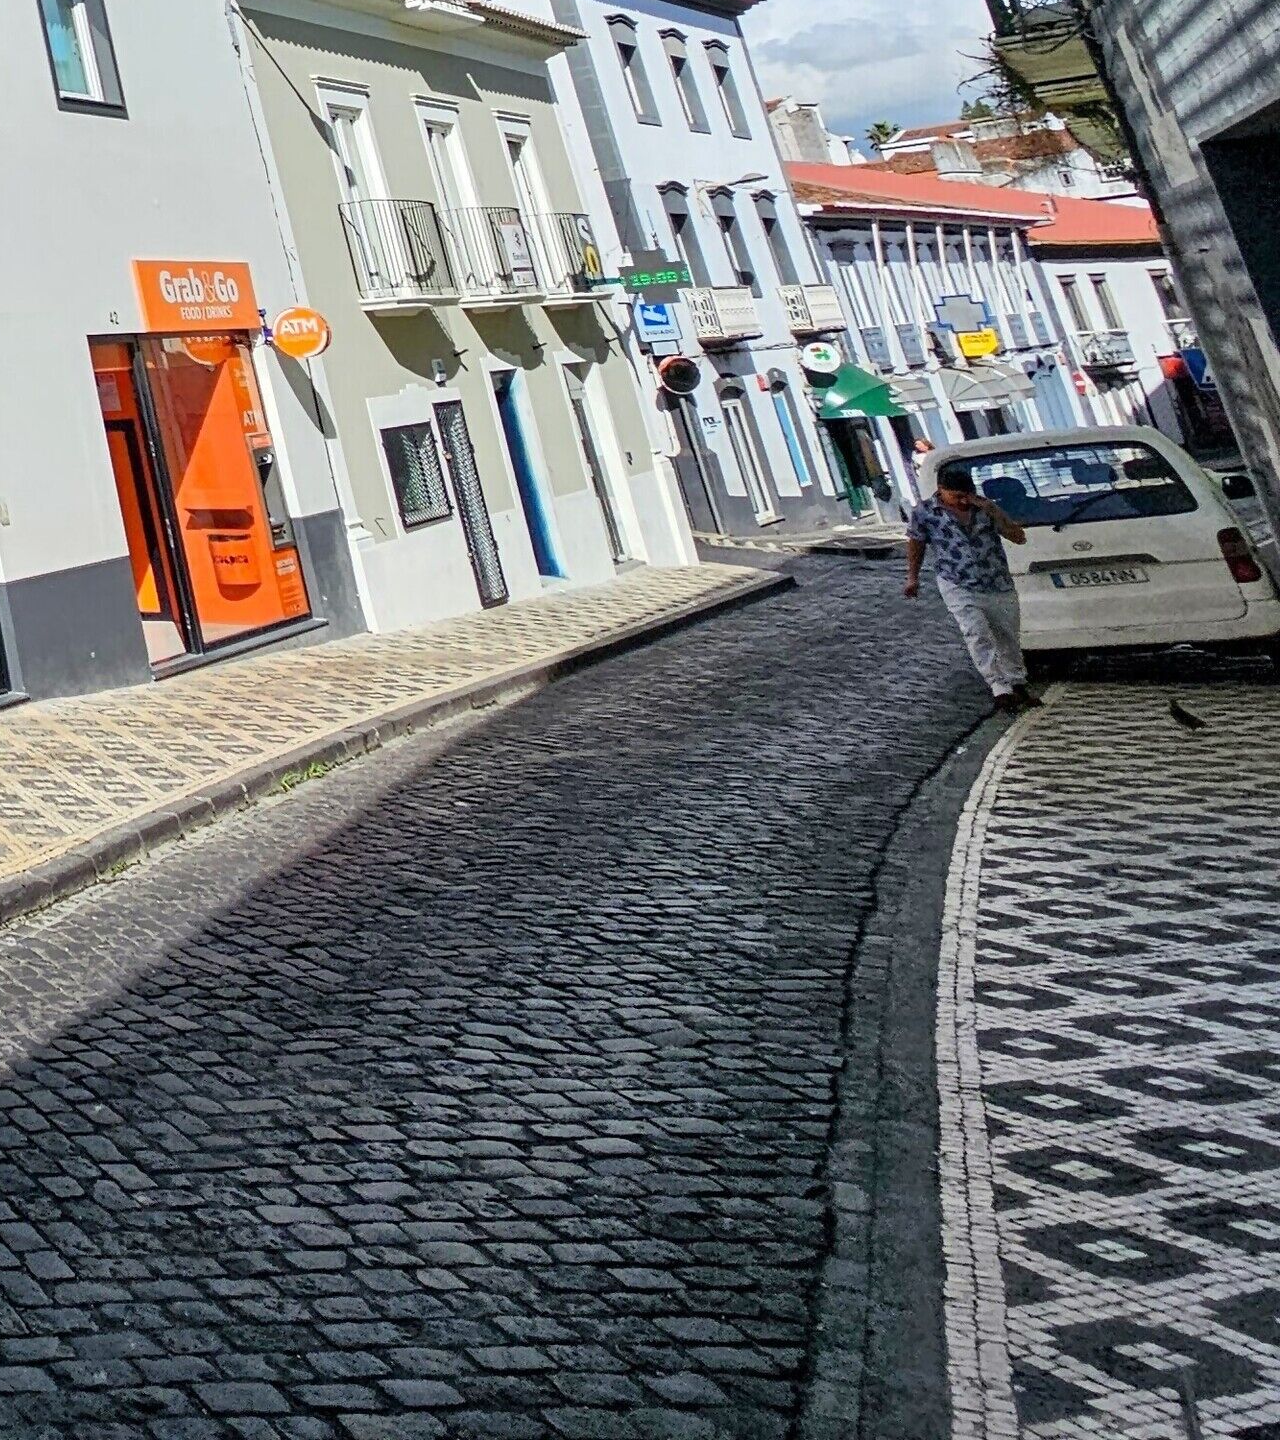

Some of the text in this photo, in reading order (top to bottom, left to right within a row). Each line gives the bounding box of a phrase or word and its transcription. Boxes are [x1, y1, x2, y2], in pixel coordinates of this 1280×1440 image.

[159, 268, 240, 304] Grab&Go
[109, 311, 120, 326] 42
[279, 317, 319, 335] ATM
